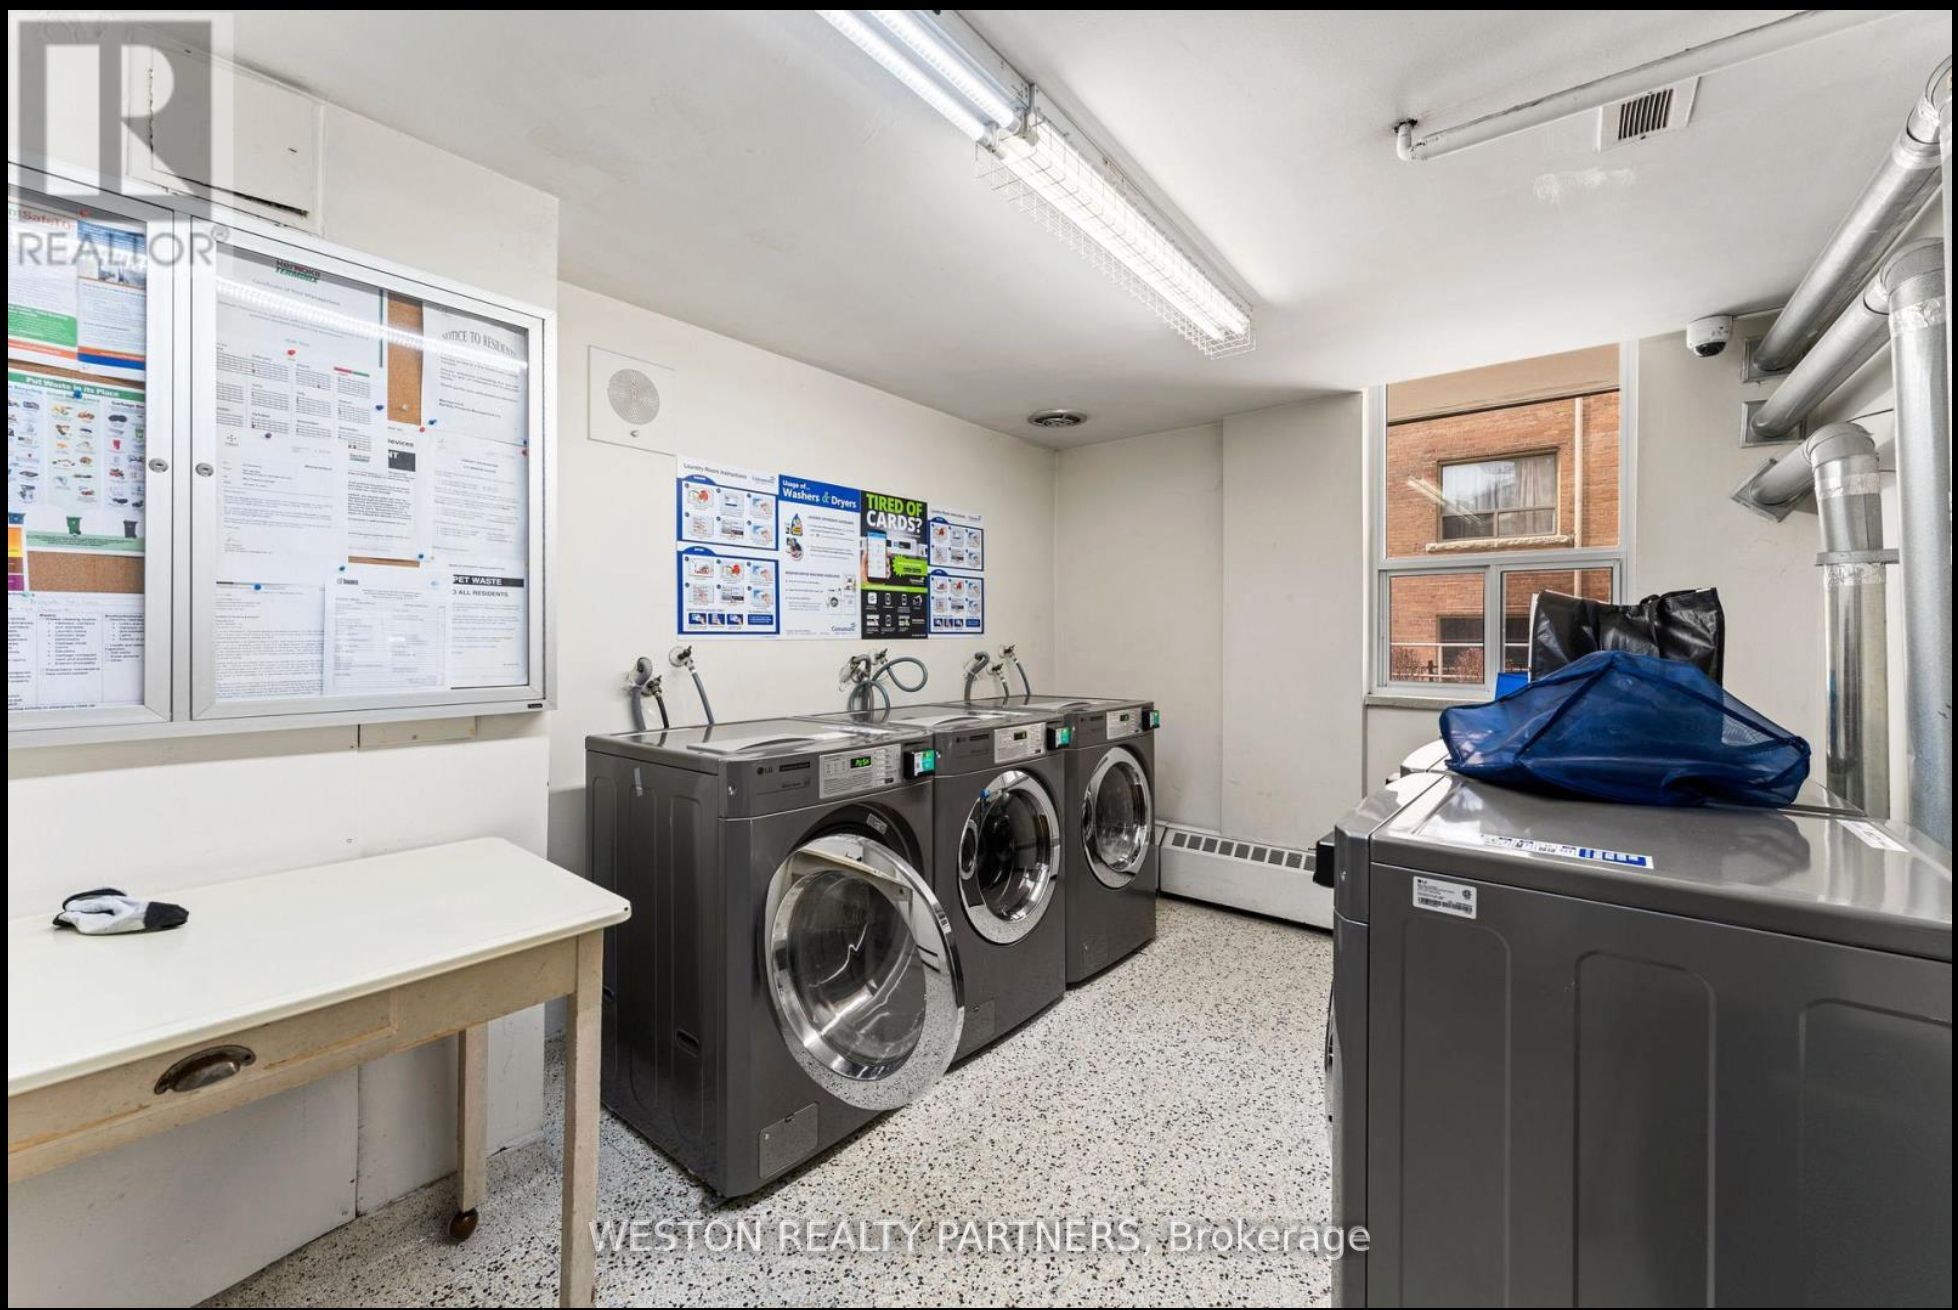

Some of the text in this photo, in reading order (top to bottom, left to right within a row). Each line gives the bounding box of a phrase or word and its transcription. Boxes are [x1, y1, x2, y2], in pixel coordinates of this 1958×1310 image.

[469, 331, 481, 345] TO
[782, 479, 800, 489] Usage
[782, 486, 857, 510] Washers & Dryers
[866, 493, 904, 514] TIRED
[906, 501, 923, 517] OF
[866, 511, 923, 534] CARDS?
[453, 575, 503, 586] PET WASTE
